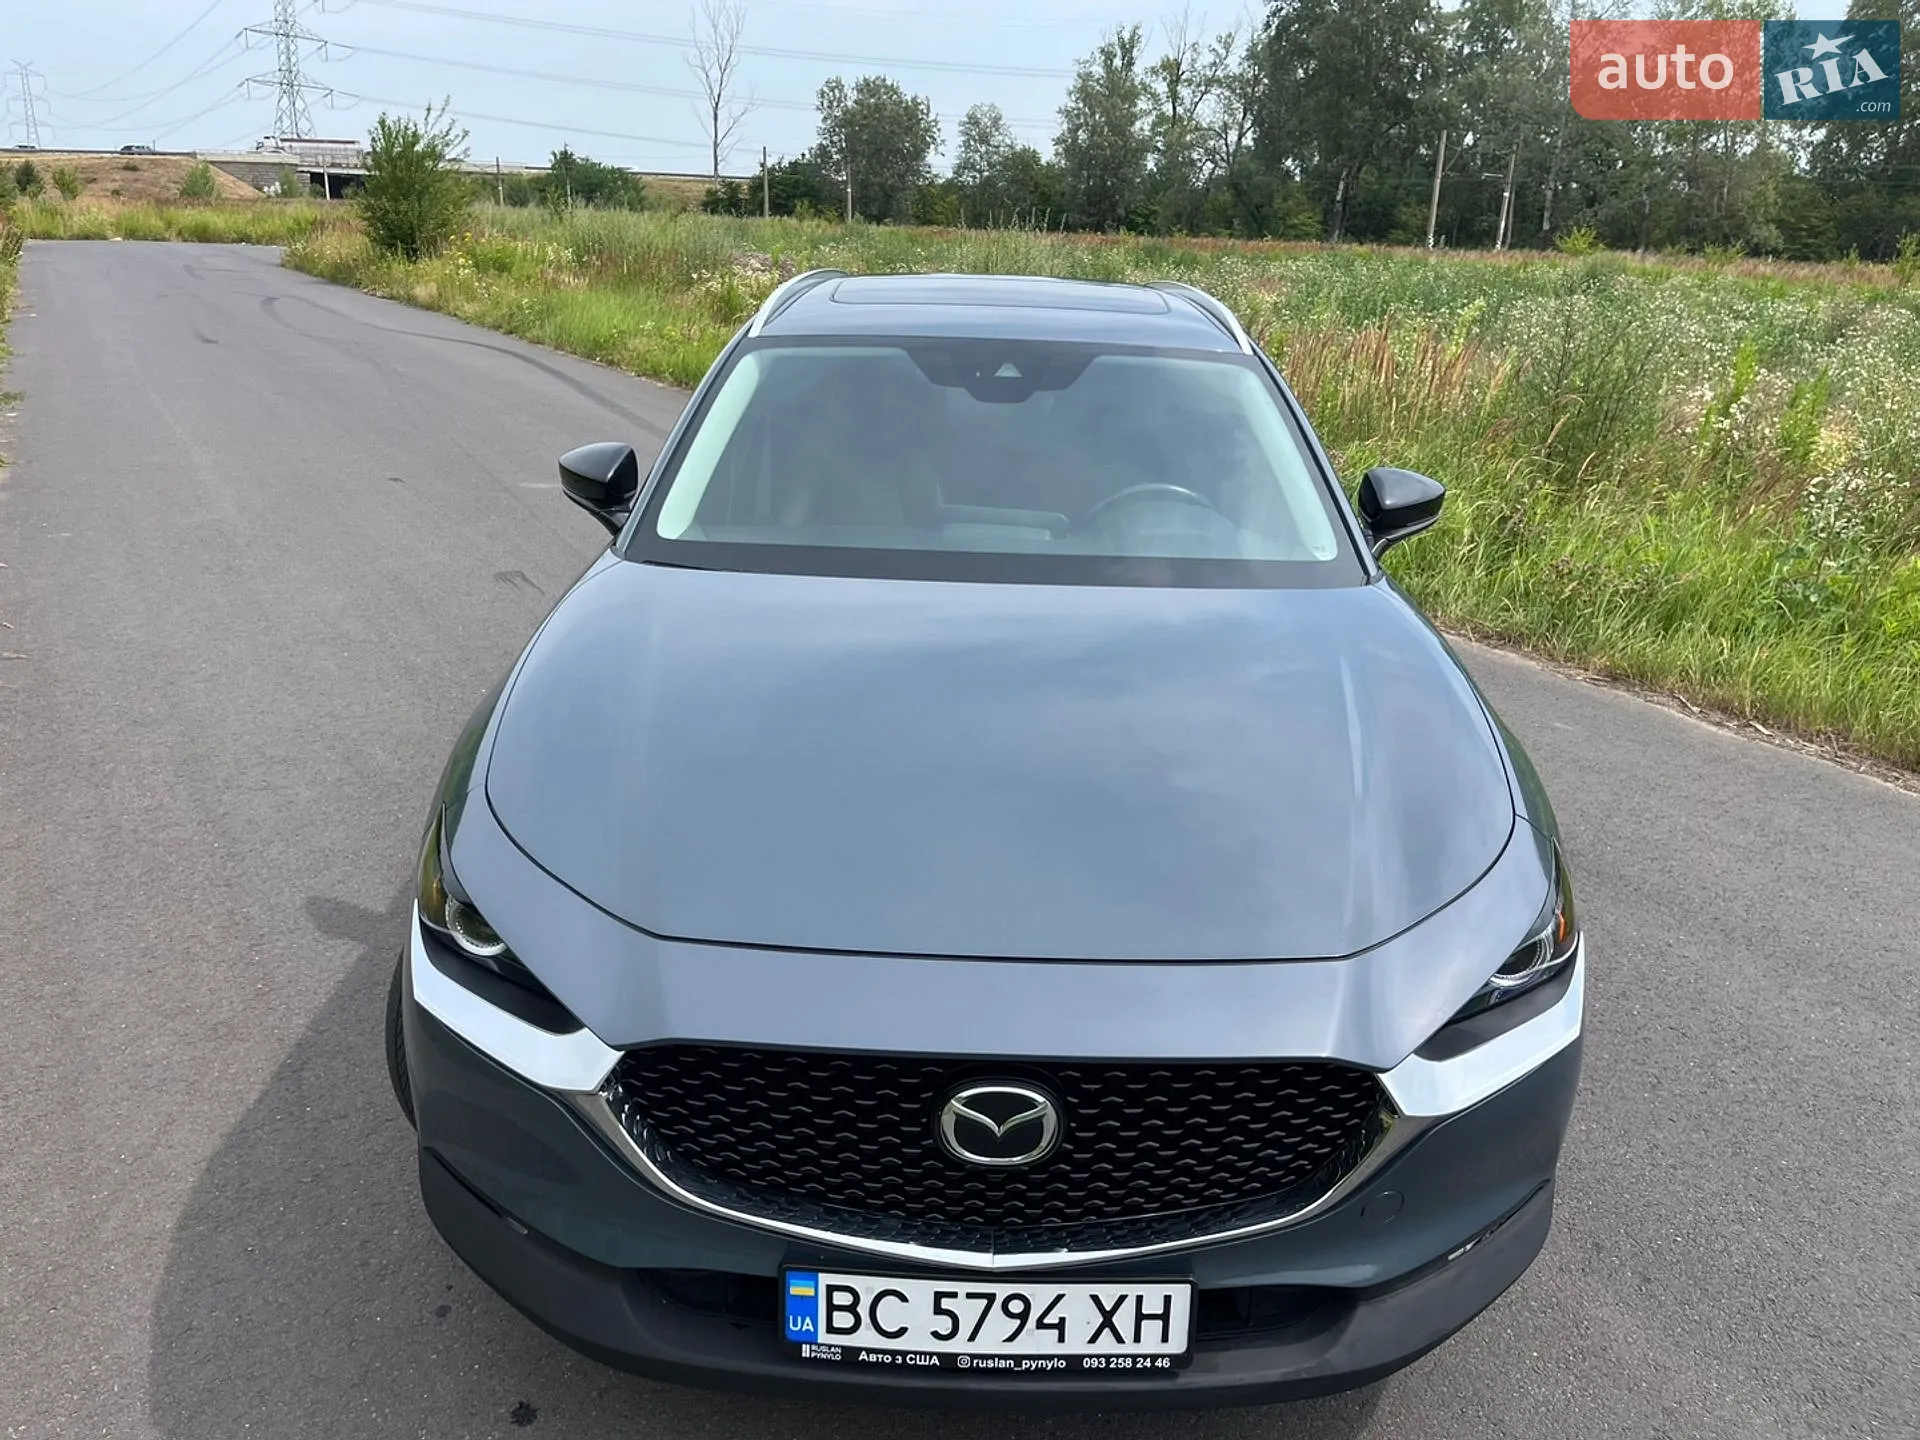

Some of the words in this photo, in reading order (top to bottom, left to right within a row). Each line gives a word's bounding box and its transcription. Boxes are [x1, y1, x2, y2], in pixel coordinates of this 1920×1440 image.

[824, 1283, 910, 1340] BC
[930, 1290, 1067, 1344] 5794
[1086, 1293, 1173, 1344] XH
[789, 1315, 815, 1333] UA
[810, 1344, 842, 1353] RUSLAN
[810, 1352, 842, 1361] PYNYLO
[858, 1351, 892, 1364] Авто
[906, 1353, 940, 1366] США
[1082, 1357, 1106, 1369] 093
[1109, 1357, 1133, 1369] 258
[1135, 1357, 1151, 1369] 24
[1154, 1357, 1171, 1369] 46
[973, 1357, 1067, 1371] ruslan_pynylo
